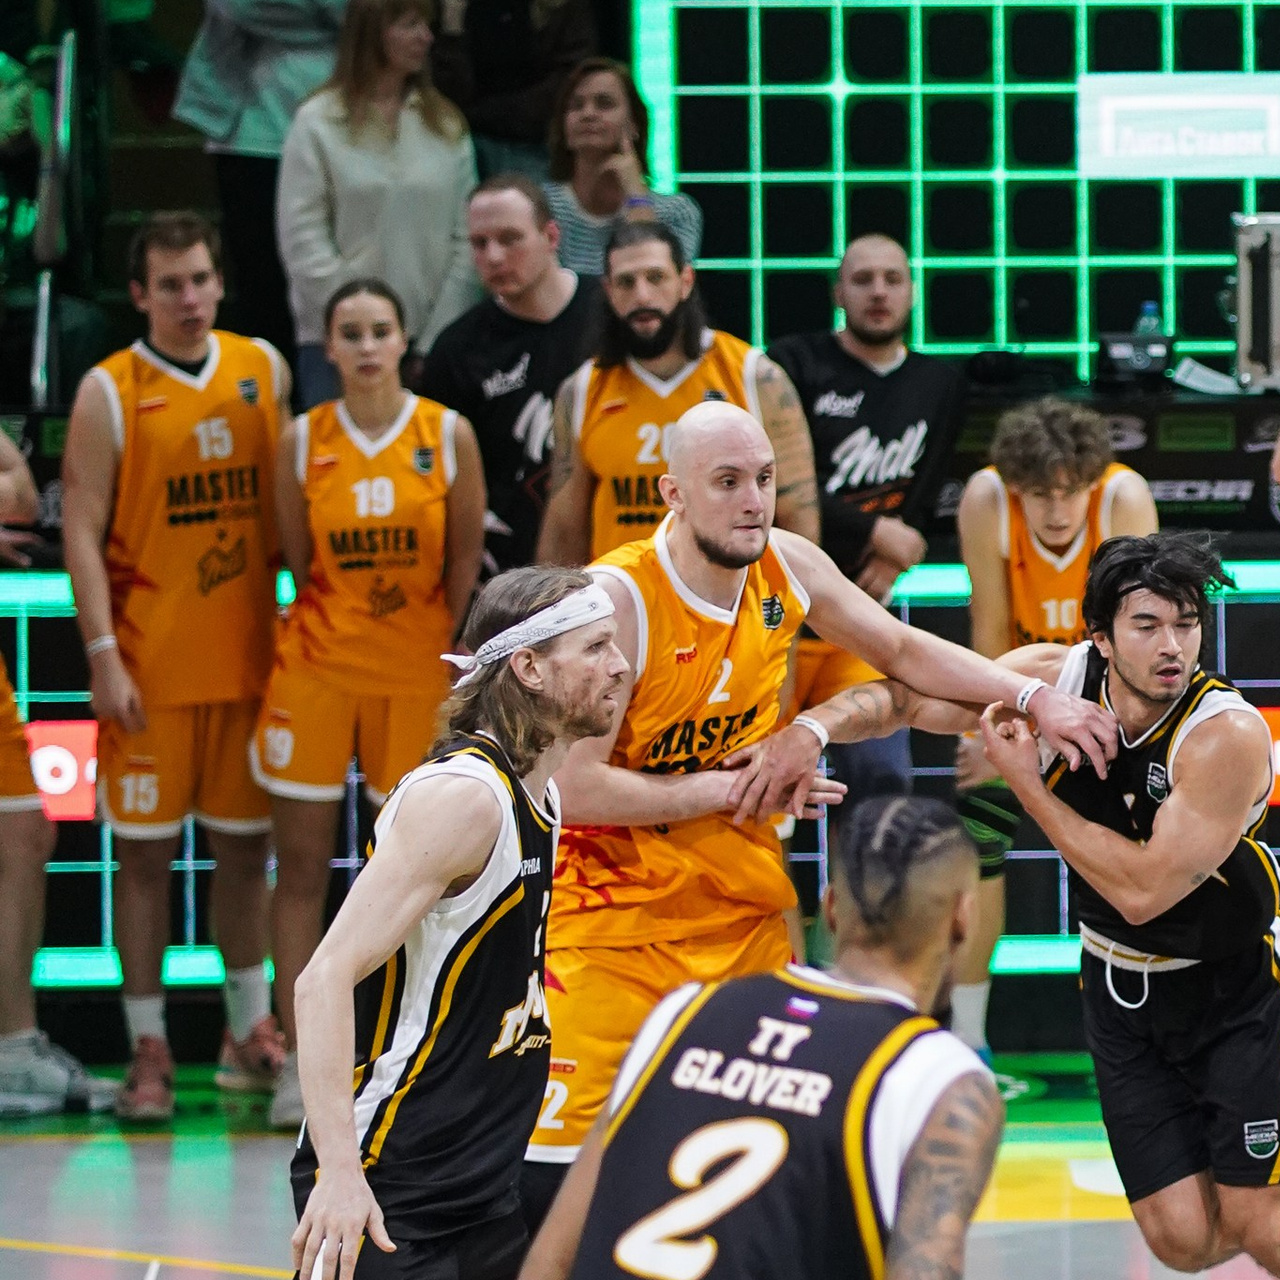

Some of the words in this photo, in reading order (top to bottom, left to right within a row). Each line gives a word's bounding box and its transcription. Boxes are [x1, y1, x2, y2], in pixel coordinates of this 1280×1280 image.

[193, 418, 234, 462] 15
[351, 476, 396, 519] 19
[612, 475, 665, 507] MAS
[327, 526, 418, 556] MASTER
[118, 773, 160, 814] 15
[749, 1016, 812, 1062] TY
[671, 1047, 833, 1118] GLOVER
[538, 1079, 569, 1130] 2
